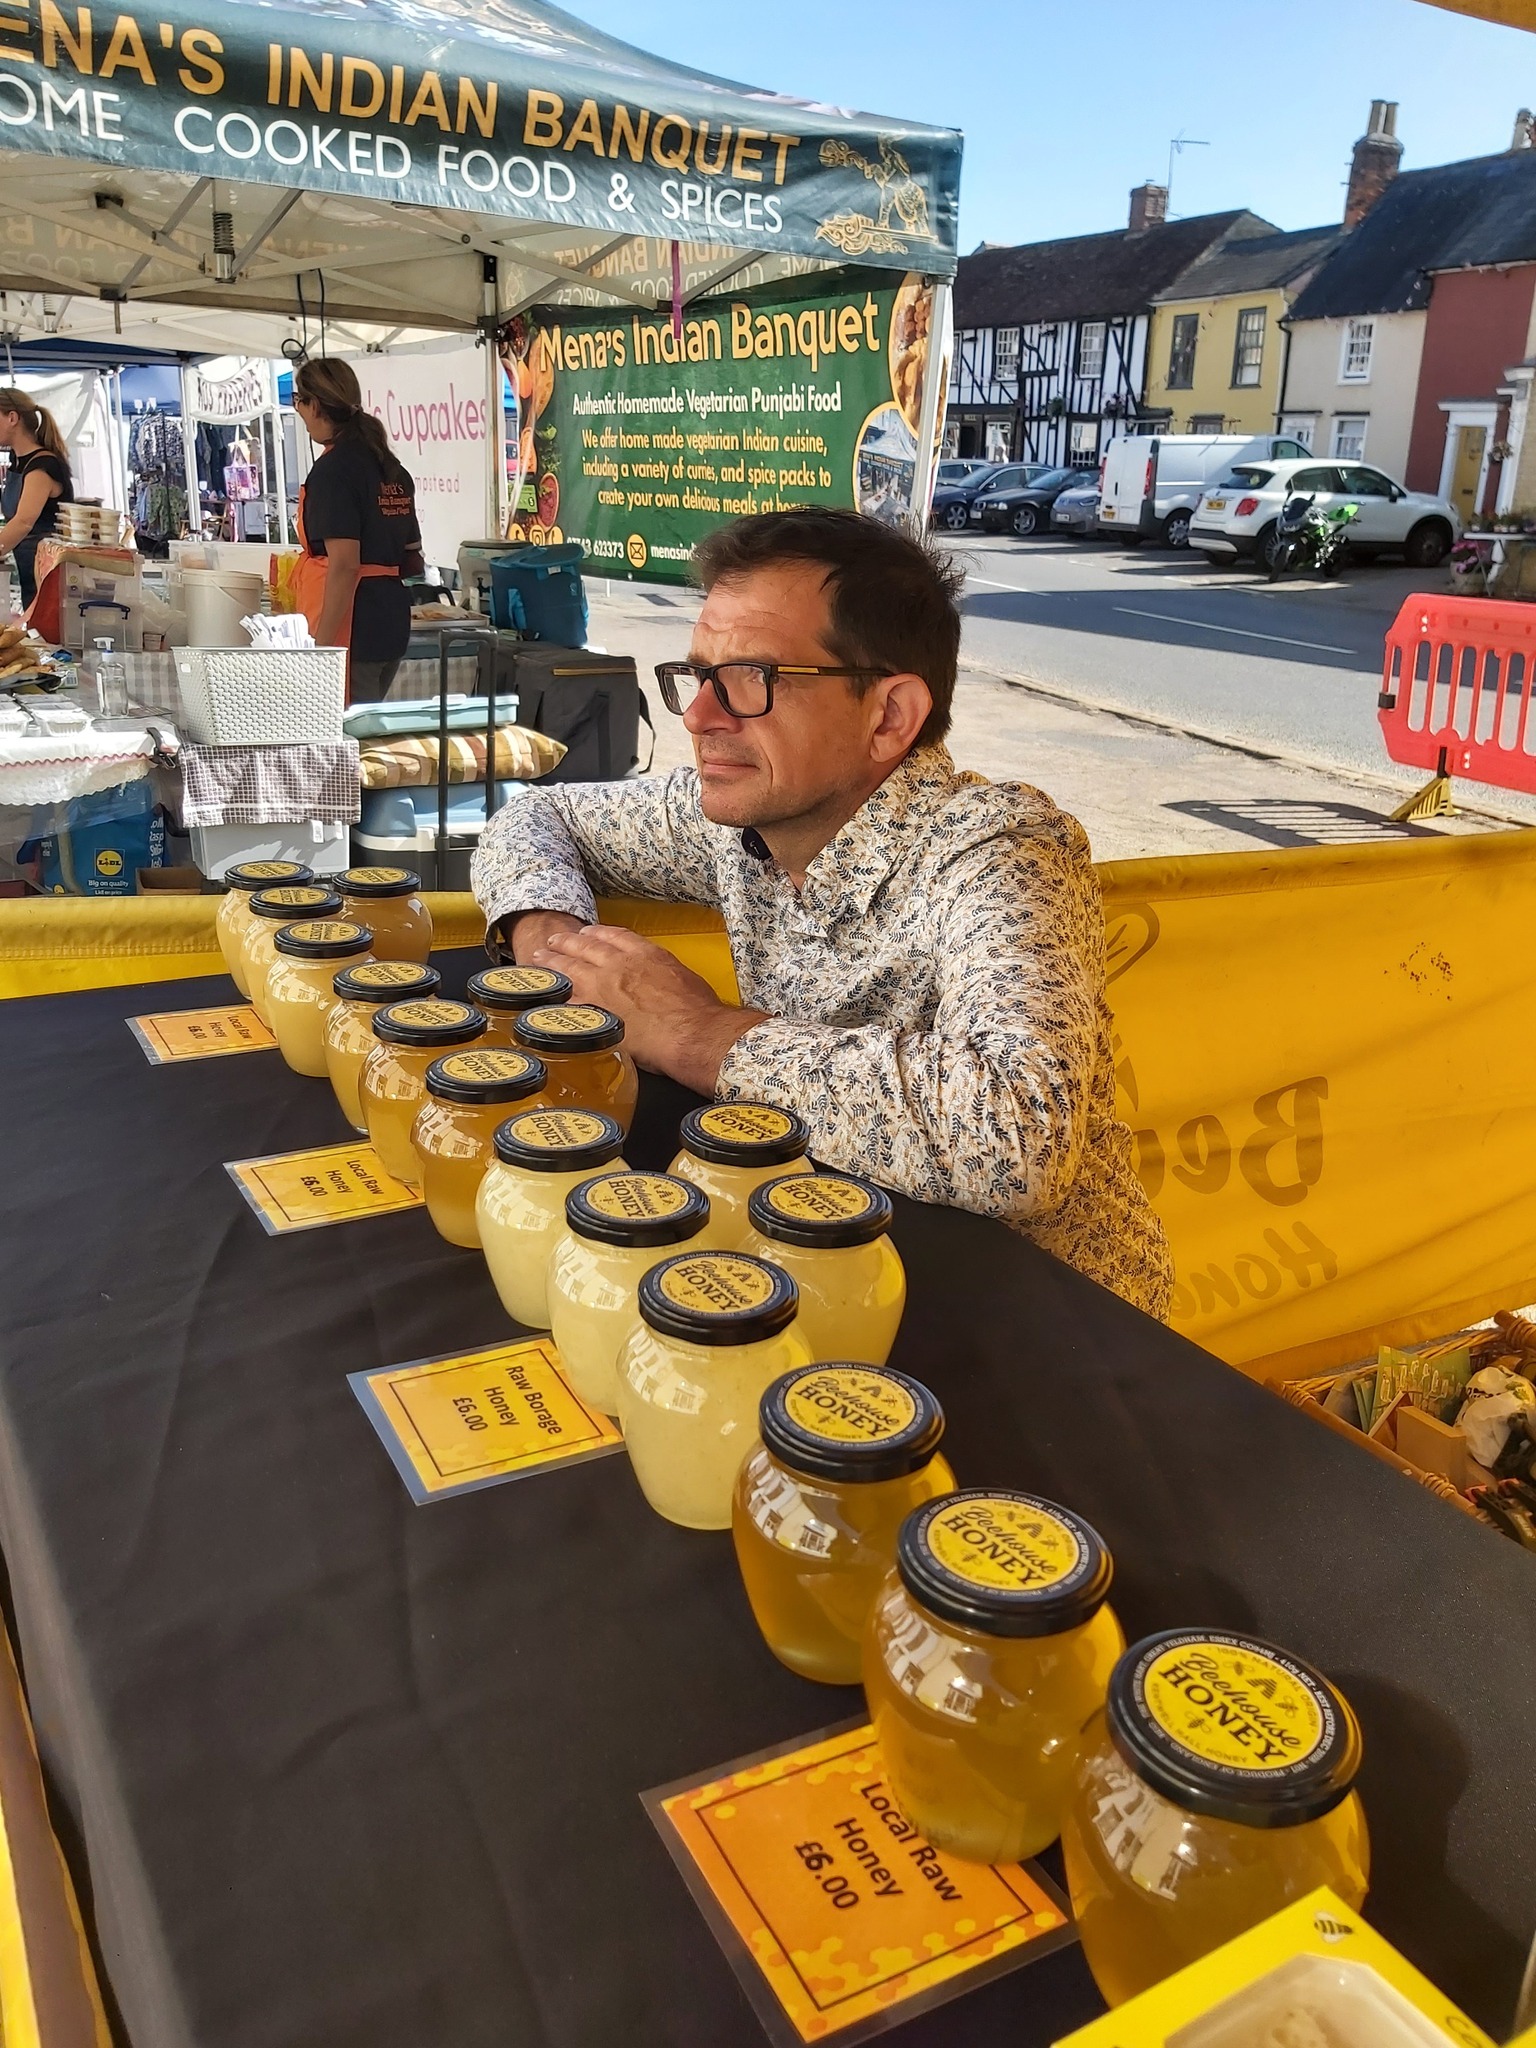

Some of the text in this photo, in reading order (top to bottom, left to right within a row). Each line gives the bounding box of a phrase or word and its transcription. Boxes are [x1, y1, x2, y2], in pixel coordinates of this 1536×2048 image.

[267, 43, 498, 138] INDIAN
[523, 88, 801, 186] BANQUET
[174, 106, 412, 179] COOKED
[437, 144, 577, 203] FOOD
[607, 172, 636, 214] &
[661, 180, 783, 234] SPICES
[539, 291, 881, 373] Mena's Indian Banquet
[573, 380, 842, 420] Authentic Homemade Vegetarian Punjabi Food
[387, 382, 486, 456] Cupcakes
[582, 425, 828, 457] We offer home made vegetarian Indian cuisine,
[581, 455, 832, 492] including a variety of curries, and spice packs to
[598, 488, 625, 505] create
[626, 490, 652, 512] your
[655, 493, 679, 509] own
[682, 486, 720, 513] delicious
[723, 491, 758, 515] meals
[761, 497, 774, 514] at
[593, 540, 625, 559] 623373
[538, 1010, 584, 1031] HONEY
[457, 1055, 497, 1080] HONEY
[531, 1116, 566, 1146] HONEY
[708, 1112, 773, 1140] HONEY
[300, 1175, 328, 1197] £6.00
[325, 1169, 354, 1194] Honey
[346, 1159, 384, 1195] Local Raw
[608, 1180, 646, 1217] HONEY
[781, 1184, 842, 1219] HONEY
[452, 1396, 489, 1432] £6.00
[483, 1386, 520, 1427] Honey
[505, 1365, 563, 1435] Raw Borage
[795, 1384, 890, 1437] HONEY
[810, 1376, 900, 1426] Beehouse
[941, 1515, 1046, 1585] HONEY
[962, 1505, 1058, 1574] Beehouse
[1207, 1635, 1238, 1646] ESSEX
[1215, 1648, 1318, 1728] 100% NATURAL ORIGIN
[1296, 1669, 1319, 1687] NET
[1158, 1664, 1288, 1762] HONEY
[1180, 1652, 1302, 1750] Beehouse
[1313, 1689, 1333, 1707] BEST
[1322, 1707, 1336, 1737] BEFORE
[1202, 1746, 1248, 1763] HONEY
[1317, 1733, 1335, 1752] DEC
[833, 1816, 904, 1900] Honey
[860, 1781, 963, 1903] Local Raw
[793, 1840, 860, 1910] £6.00
